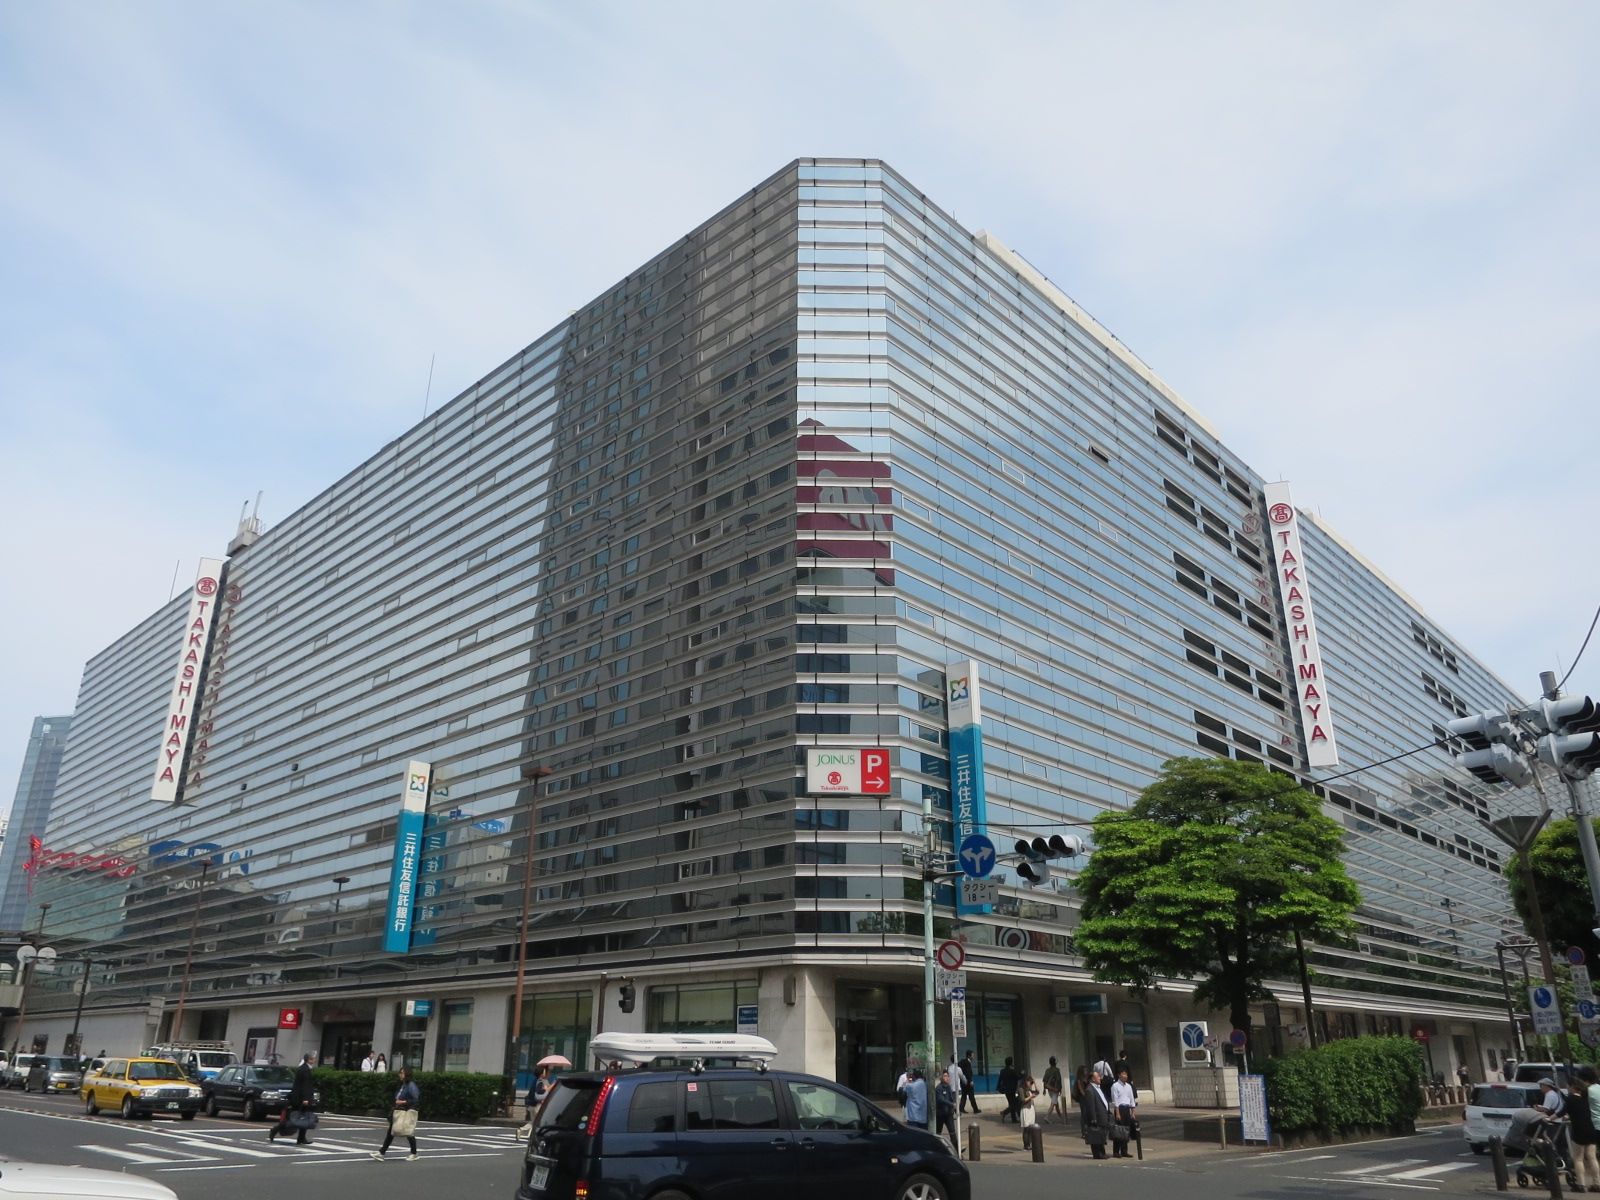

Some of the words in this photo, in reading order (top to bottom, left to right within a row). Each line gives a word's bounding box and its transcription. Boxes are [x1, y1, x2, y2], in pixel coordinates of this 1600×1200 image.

[1278, 531, 1328, 742] TAKASHIMAYA
[159, 601, 209, 783] TAKASHIMAYA
[816, 753, 855, 767] JOINUS
[867, 754, 882, 773] P
[394, 832, 417, 932] 三井住友信託銀行
[963, 883, 995, 892] タクシー
